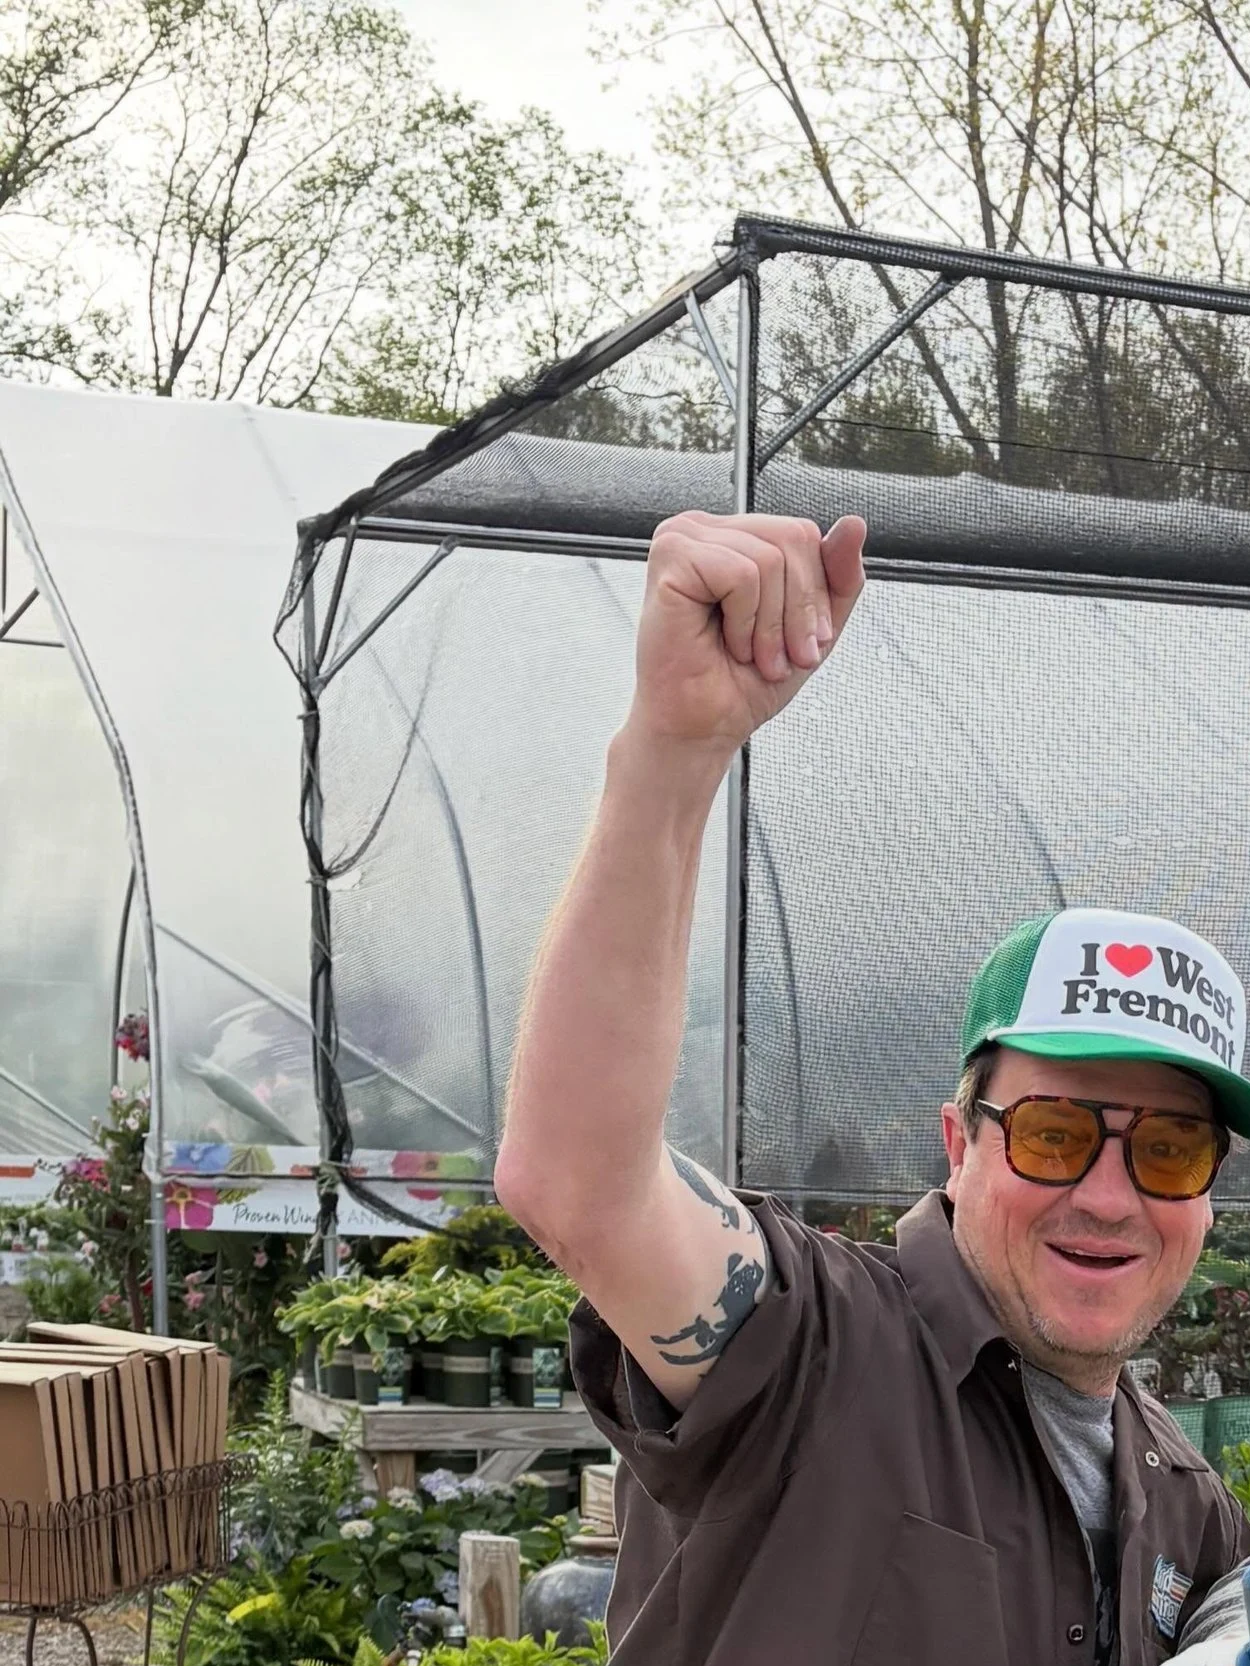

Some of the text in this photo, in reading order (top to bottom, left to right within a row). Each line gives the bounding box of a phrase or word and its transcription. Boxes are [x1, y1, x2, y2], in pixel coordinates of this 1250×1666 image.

[1060, 978, 1236, 1072] Fremont
[1079, 942, 1236, 1031] I West
[232, 1203, 281, 1225] Proven
